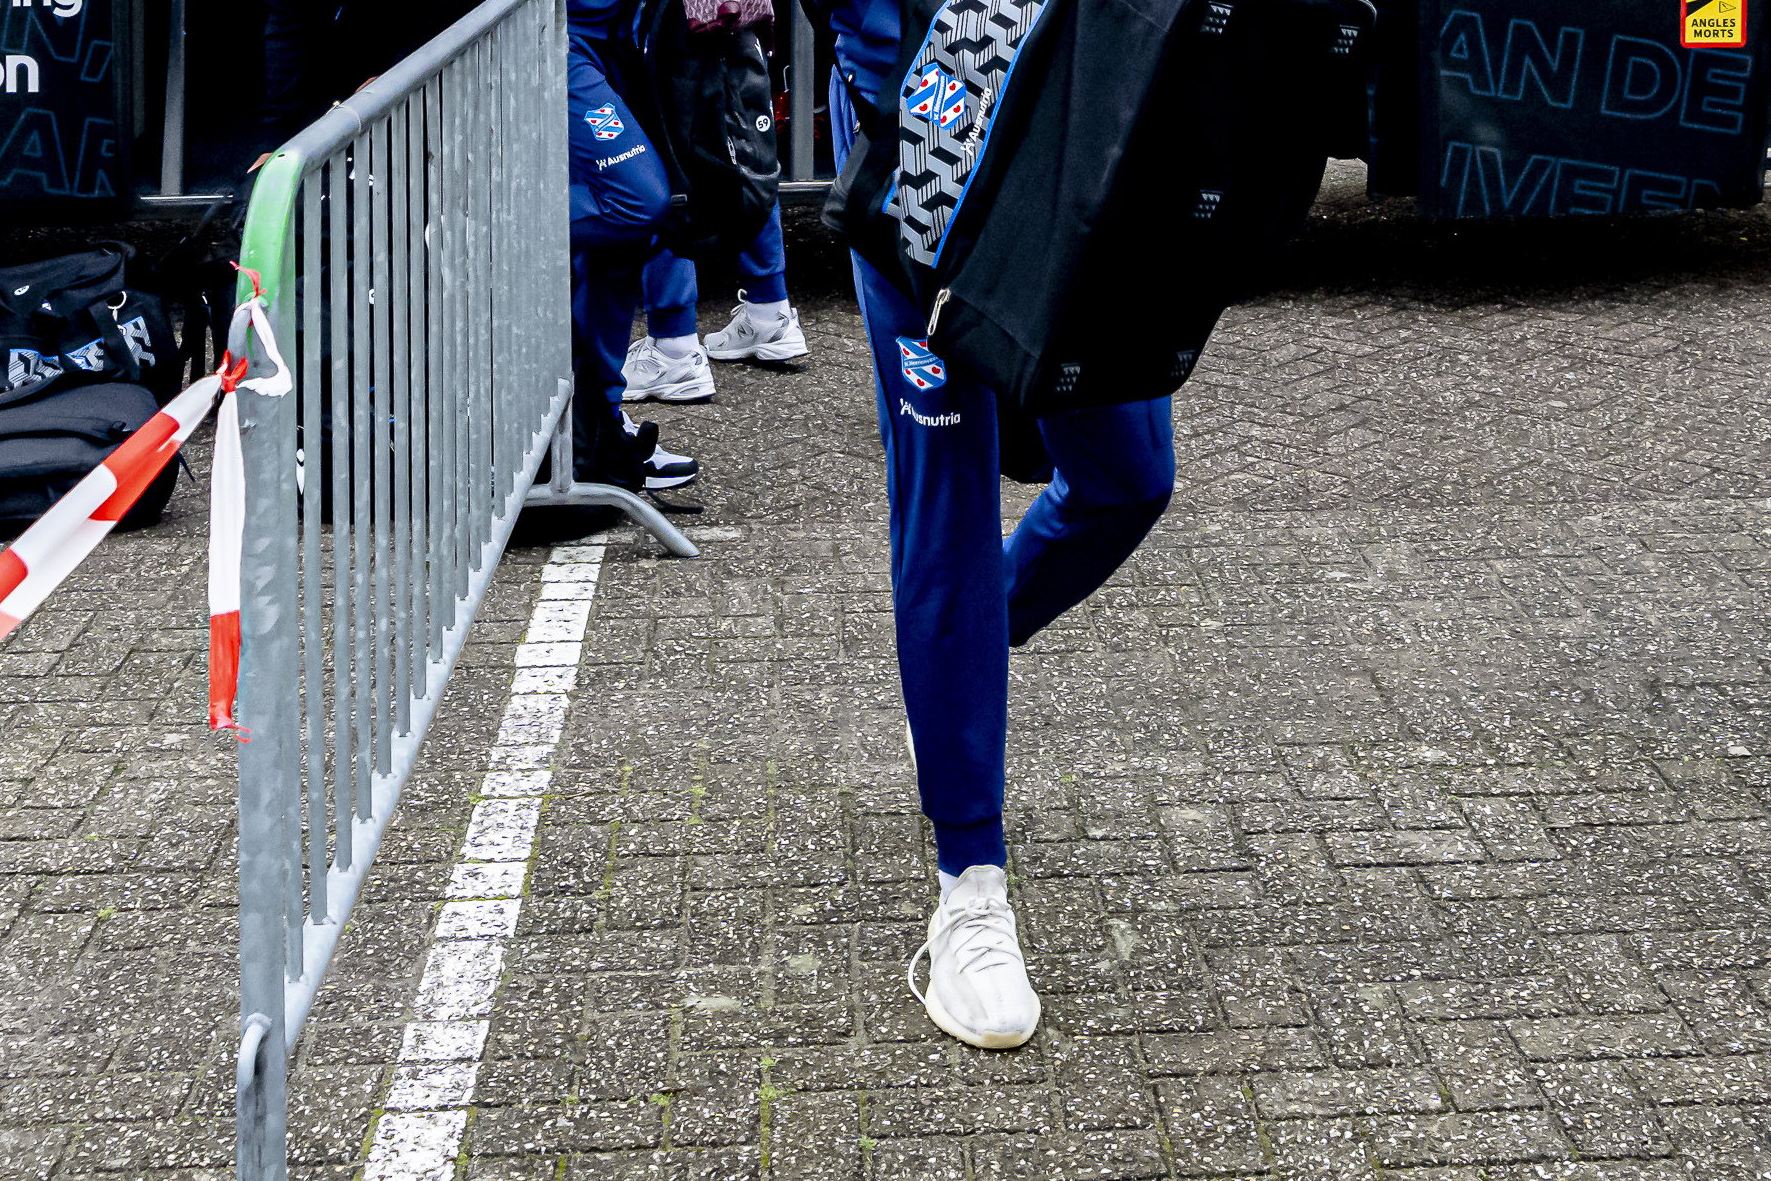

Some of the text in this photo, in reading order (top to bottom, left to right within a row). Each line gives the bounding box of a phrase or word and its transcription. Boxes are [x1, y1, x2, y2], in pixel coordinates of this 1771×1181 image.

[1691, 19, 1736, 27] ANGLES
[1693, 29, 1734, 38] MORTS
[757, 119, 769, 129] 59
[608, 144, 646, 166] Ausnutria
